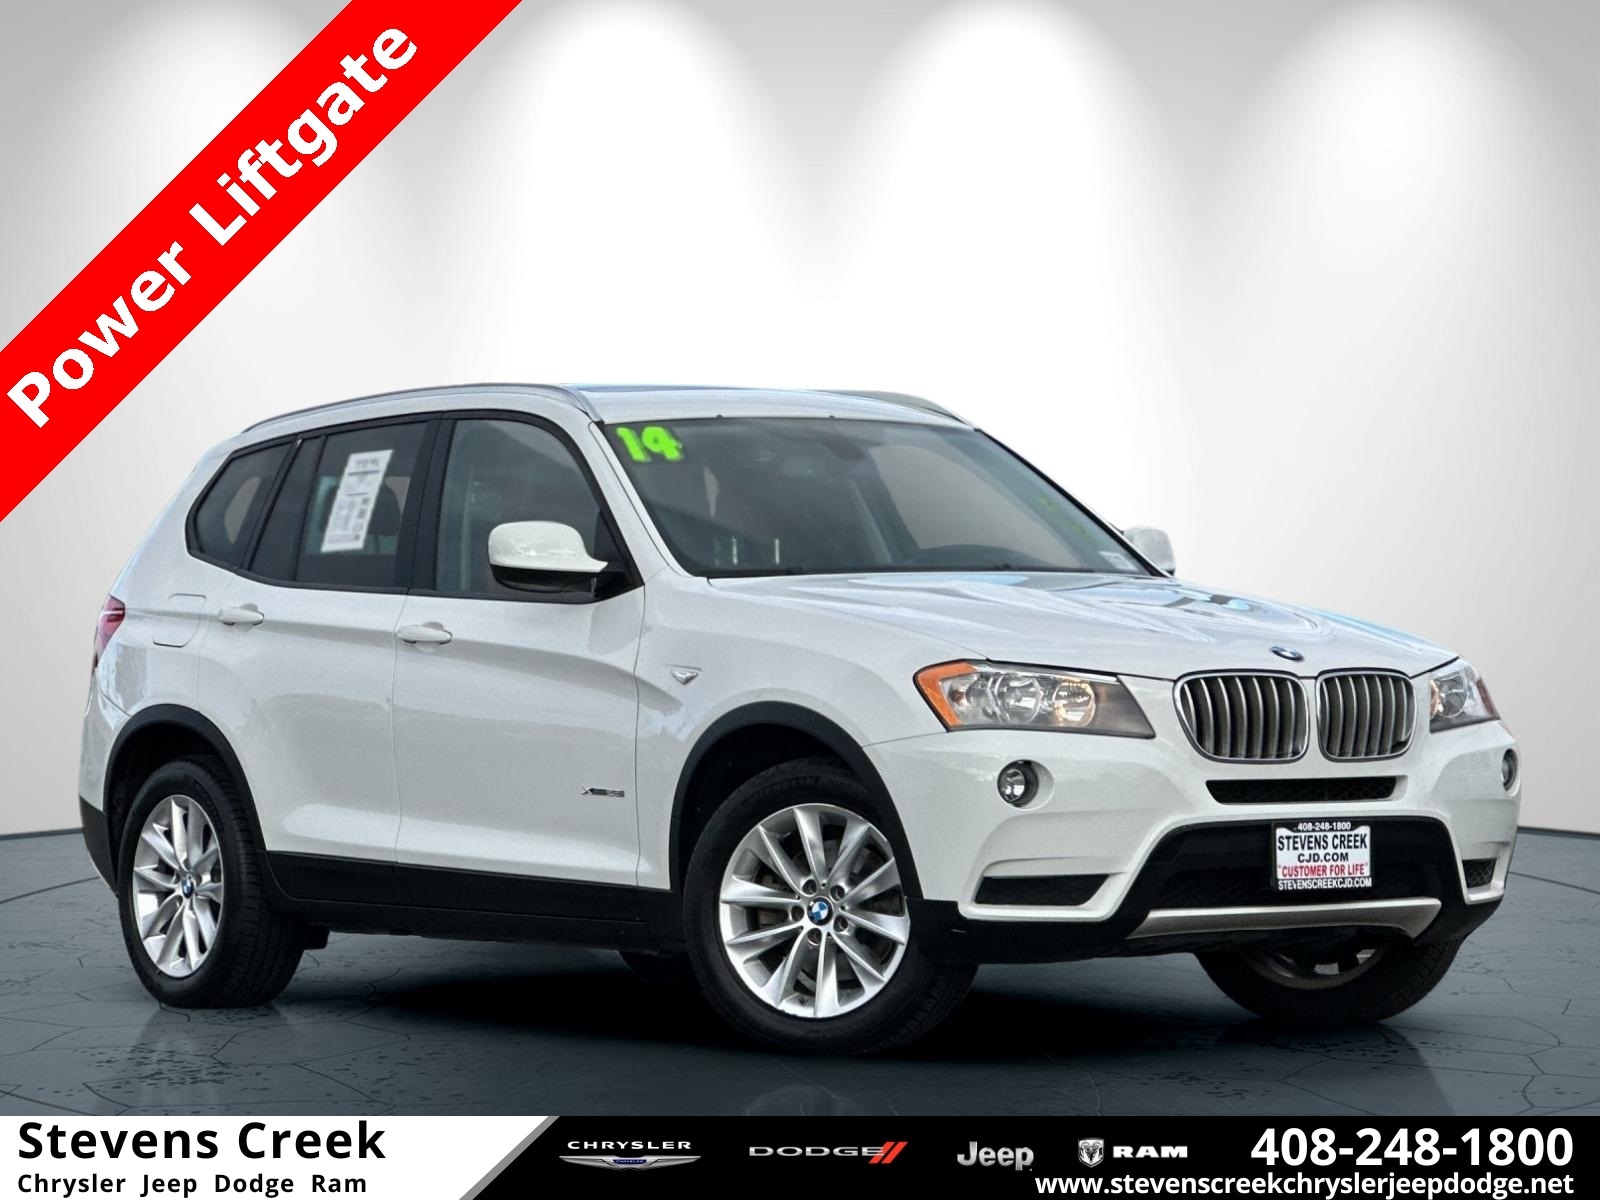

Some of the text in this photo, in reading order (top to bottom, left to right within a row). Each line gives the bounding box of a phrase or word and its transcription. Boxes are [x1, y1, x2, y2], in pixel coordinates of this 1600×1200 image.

[1297, 822, 1351, 831] 408-248-1800
[1278, 833, 1368, 851] STEVENS CREEK
[1297, 852, 1349, 863] CJD.COM
[1329, 864, 1346, 876] FOR
[1278, 877, 1372, 890] STEVENSCREEKCJD.COM
